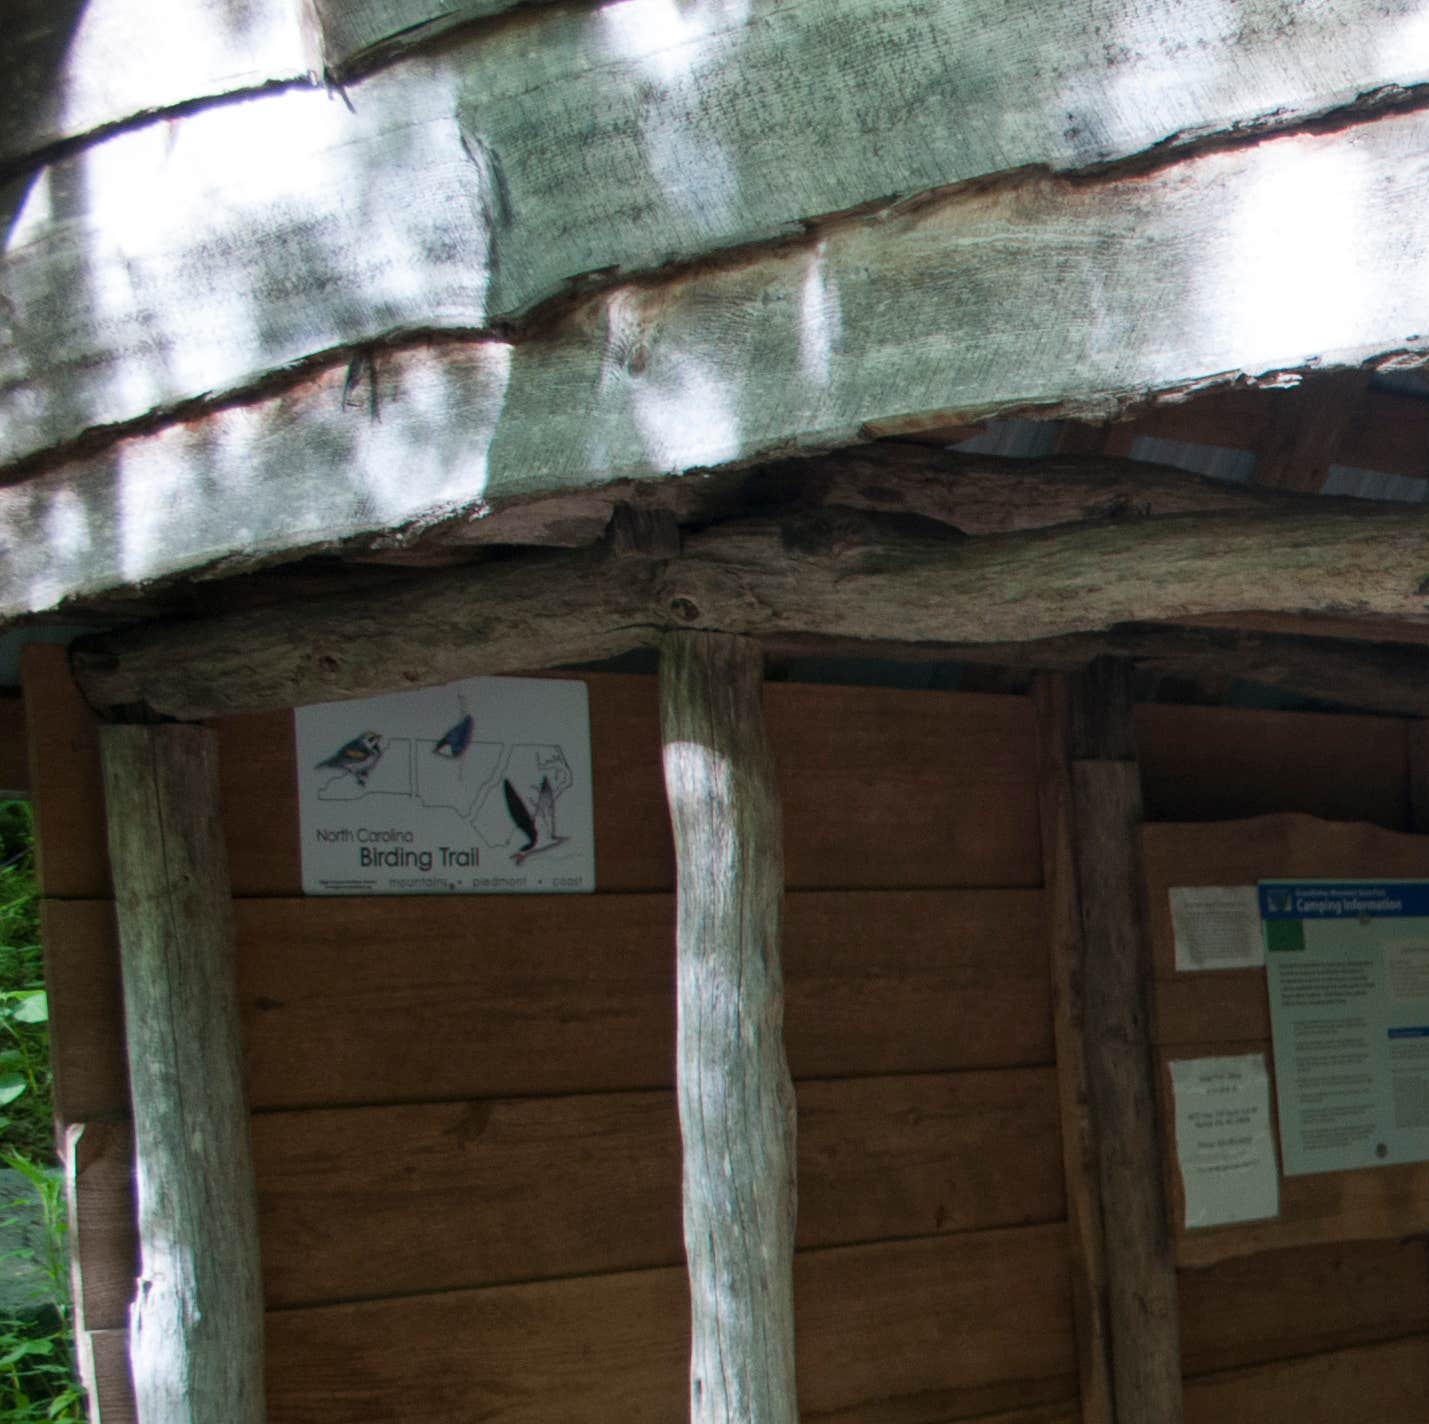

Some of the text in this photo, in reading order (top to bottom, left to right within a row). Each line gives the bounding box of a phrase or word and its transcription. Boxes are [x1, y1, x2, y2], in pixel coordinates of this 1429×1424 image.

[316, 828, 414, 843] North Carolina
[360, 847, 480, 871] Birding Trail
[389, 877, 448, 889] mountains
[472, 876, 528, 889] piedmont
[552, 876, 584, 888] coast
[1296, 897, 1404, 915] Camping Information
